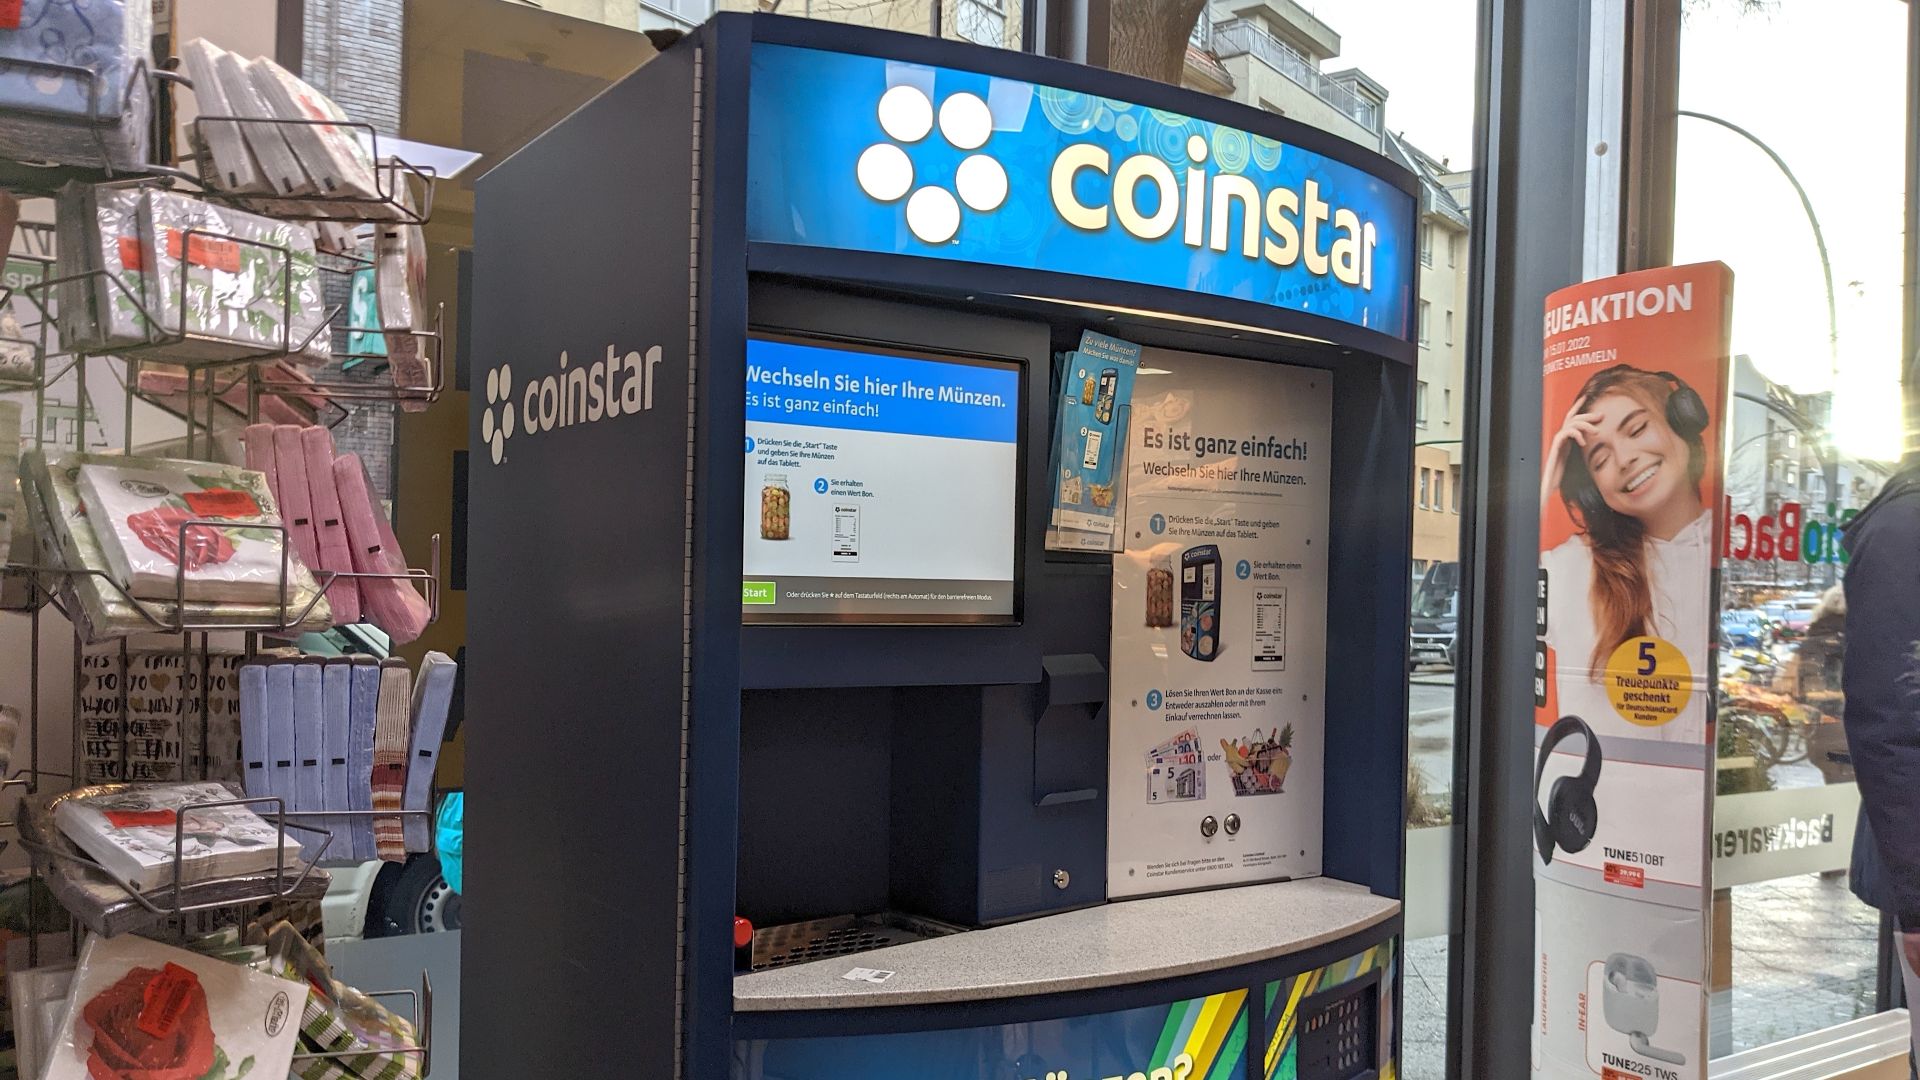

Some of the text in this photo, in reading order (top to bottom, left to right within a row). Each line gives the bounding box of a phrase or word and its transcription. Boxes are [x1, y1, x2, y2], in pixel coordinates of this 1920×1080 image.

[1050, 135, 1377, 291] coinstar
[1085, 337, 1137, 357] Zu viele Münzen?
[1564, 349, 1617, 369] SAMMELN
[523, 344, 662, 435] coinstar
[746, 365, 1006, 408] Wechseln Sie hier Ihre Münzen.
[746, 391, 879, 418] Es ist ganz einfach!
[757, 437, 783, 446] Drücken
[783, 439, 792, 447] Sie
[792, 440, 802, 448] die
[822, 442, 838, 451] Taste
[1143, 427, 1307, 461] Es ist ganz einfach!
[770, 449, 789, 457] geben
[799, 451, 811, 459] Ihre
[811, 452, 835, 460] Münzen
[768, 458, 778, 466] das
[779, 460, 801, 468] Tablett.
[1143, 461, 1307, 486] Wechseln Sie hier Ihre Münzen.
[839, 479, 864, 487] erhalten
[861, 490, 874, 498] Bon.
[1168, 515, 1194, 524] Drücken
[1194, 516, 1204, 525] Sie
[1234, 518, 1249, 527] Taste
[1250, 519, 1261, 528] und
[1261, 519, 1280, 530] geben
[1168, 527, 1259, 539] Sie Ihre Münzen auf das Tablett.
[1253, 560, 1262, 569] Sie
[1262, 561, 1286, 569] erhalten
[743, 588, 768, 598] Start
[1637, 642, 1657, 676] 5
[1616, 675, 1680, 691] Treuepunkte
[1165, 689, 1183, 698] Lösen
[1183, 689, 1193, 697] Sie
[1193, 688, 1210, 697] Ihren
[1209, 688, 1224, 697] Wert
[1225, 688, 1237, 696] Bon
[1245, 686, 1255, 696] der
[1623, 691, 1671, 703] geschenkt
[1165, 699, 1266, 710] Entweder auszahlen oder mit Ihrem
[1165, 710, 1241, 722] Einkauf verrechnen lassen.
[1207, 752, 1222, 762] oder
[1167, 766, 1175, 779] 5
[1603, 846, 1665, 867] TUNE510BT
[1578, 992, 1586, 1032] IN-EAR
[1602, 1052, 1651, 1076] TUNE225
[1654, 1066, 1678, 1080] TWS
